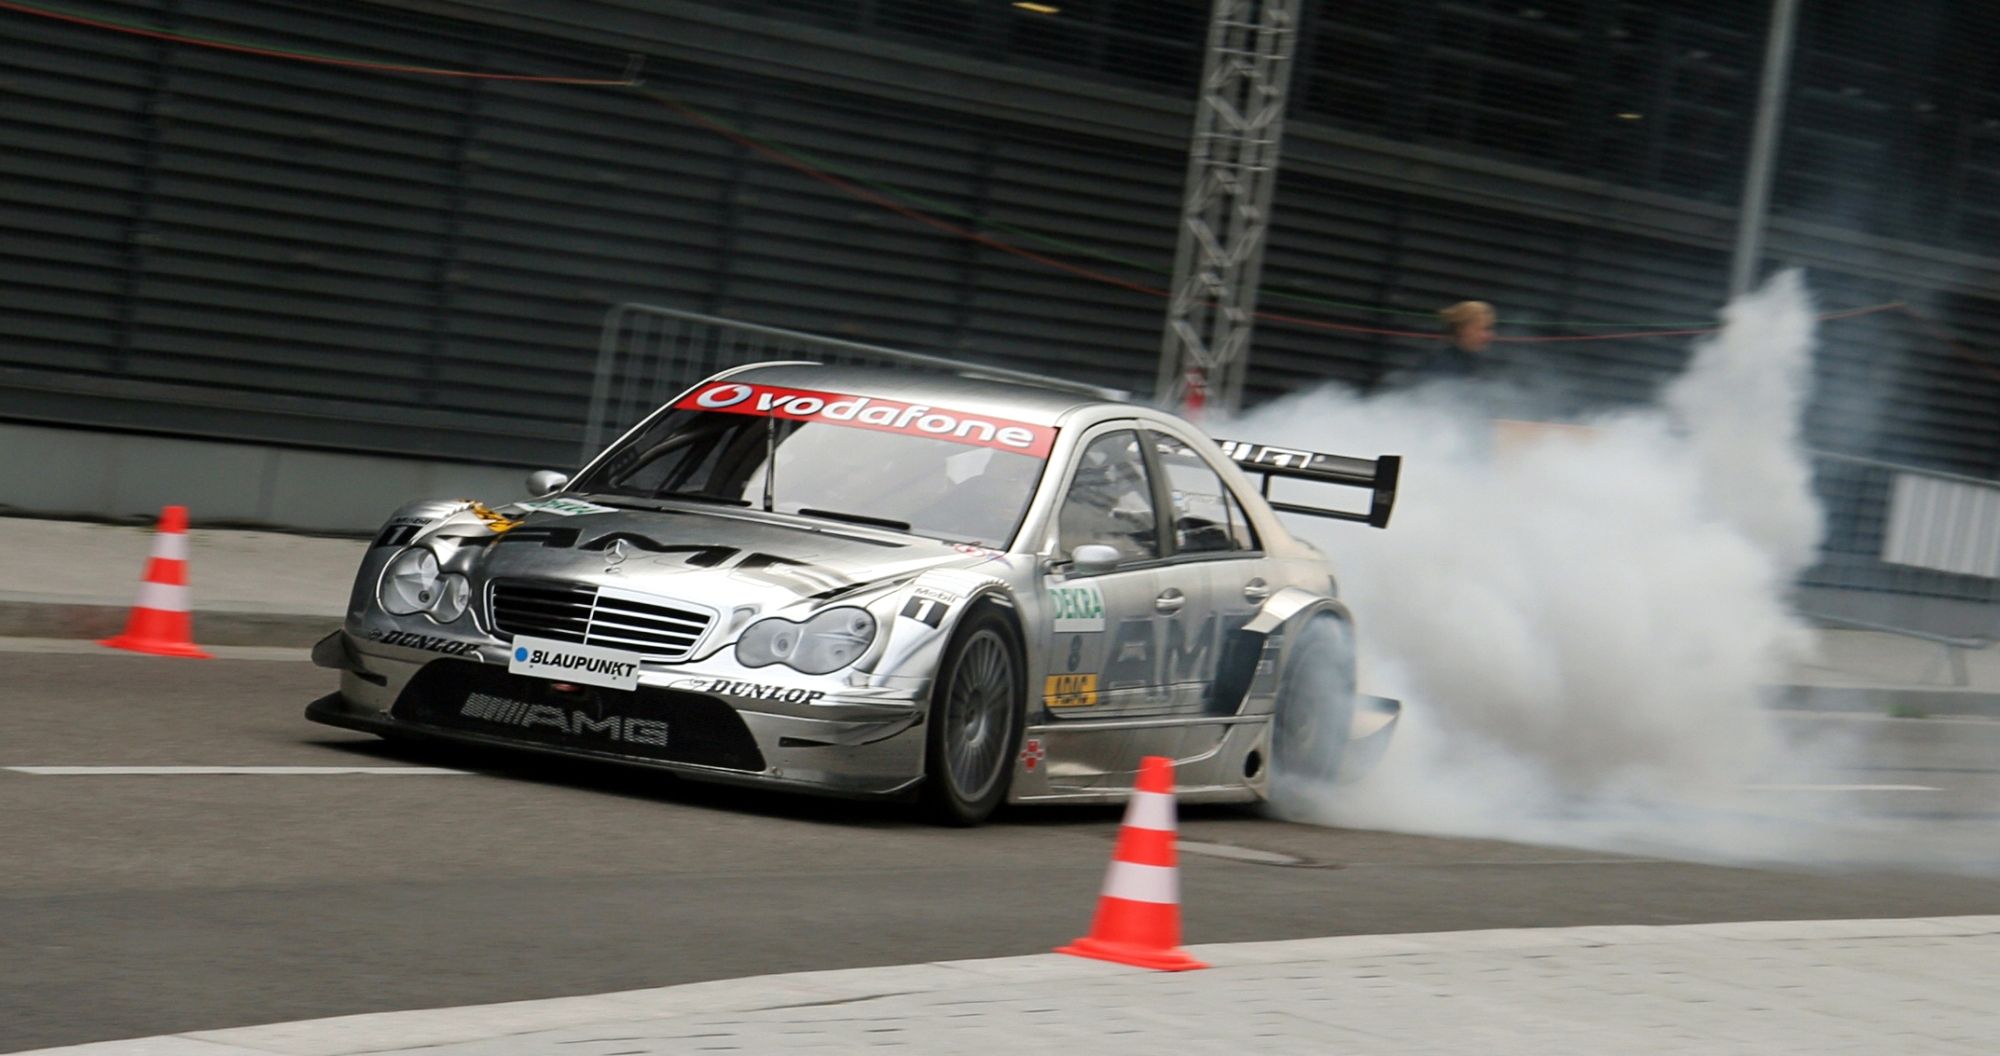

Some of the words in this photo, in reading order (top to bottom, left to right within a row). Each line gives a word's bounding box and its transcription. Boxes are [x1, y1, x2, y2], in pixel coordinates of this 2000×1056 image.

[756, 393, 1035, 449] vodafone
[914, 588, 957, 604] Mobil
[914, 599, 936, 622] 1
[381, 630, 480, 655] DUNLOP
[530, 650, 637, 678] BLAUPUNKT
[704, 679, 827, 705] DUNLOP
